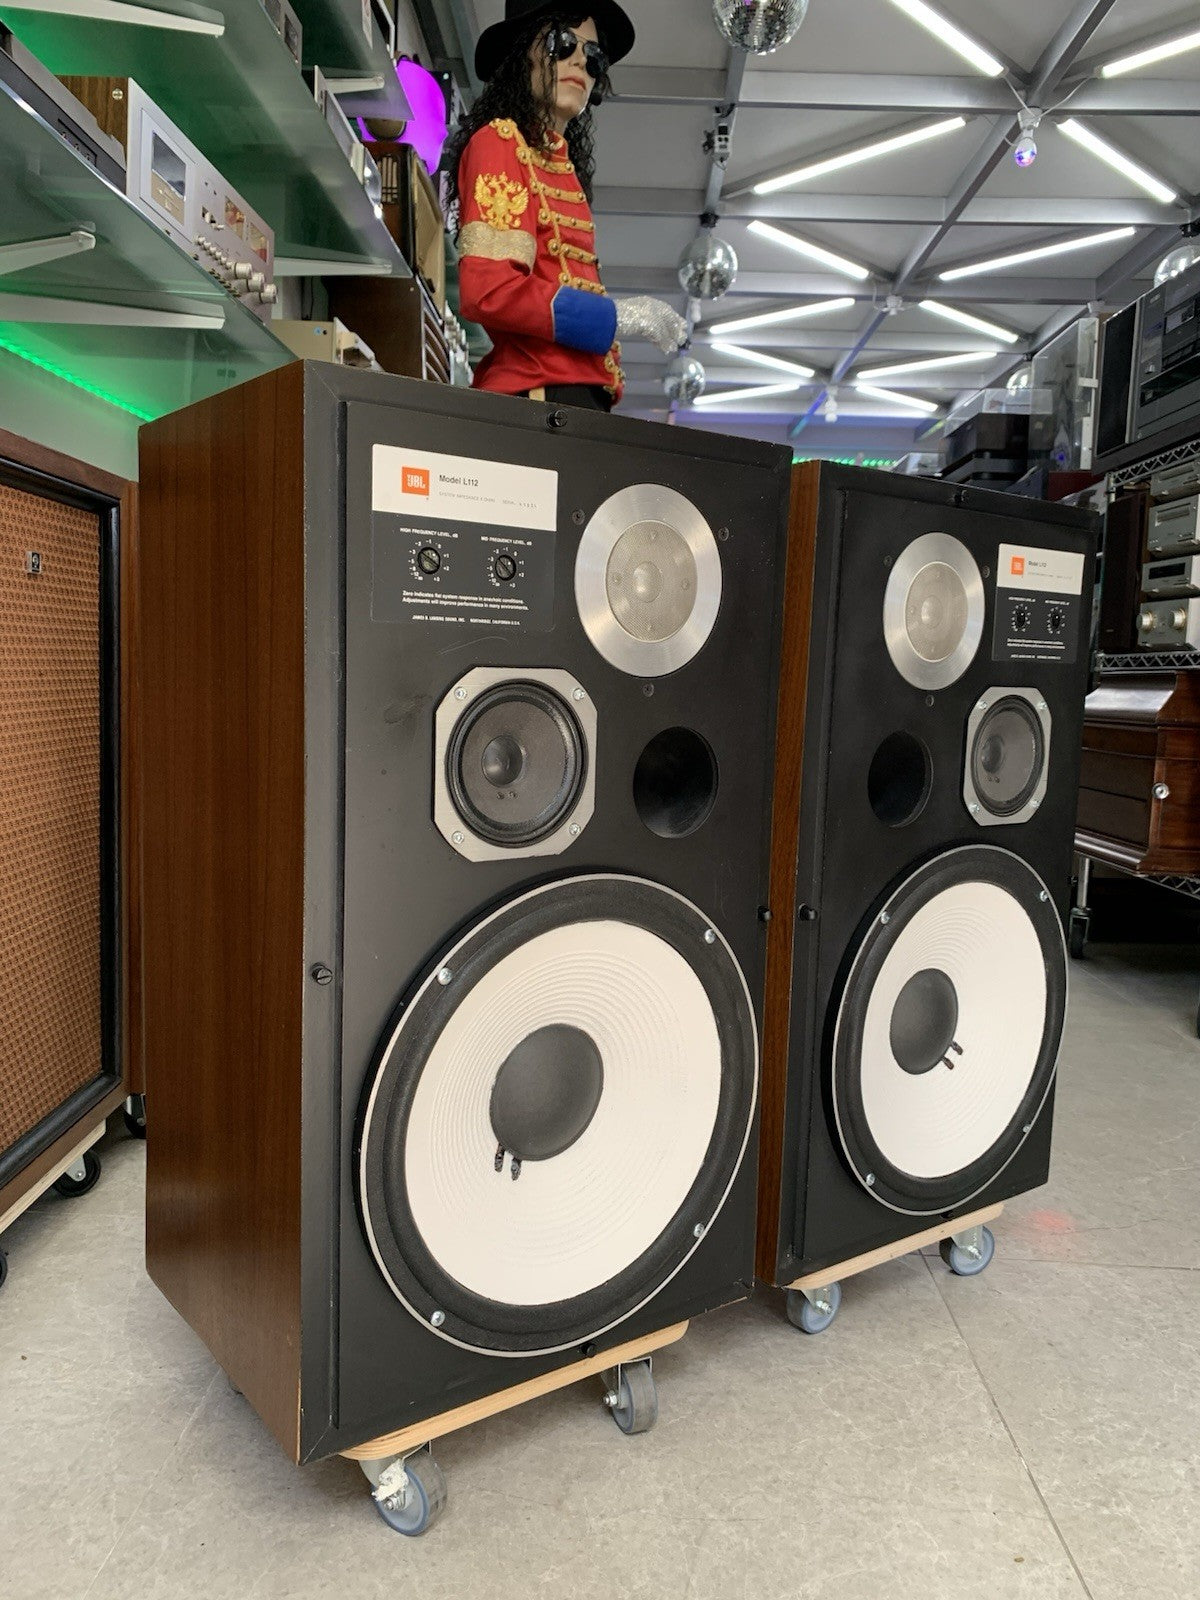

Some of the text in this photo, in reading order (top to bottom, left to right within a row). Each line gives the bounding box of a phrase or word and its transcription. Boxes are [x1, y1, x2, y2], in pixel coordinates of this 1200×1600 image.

[407, 474, 426, 489] JBL
[439, 474, 480, 487] Model L112
[411, 528, 437, 536] FREQUENCY
[489, 536, 513, 544] FREQUENCY
